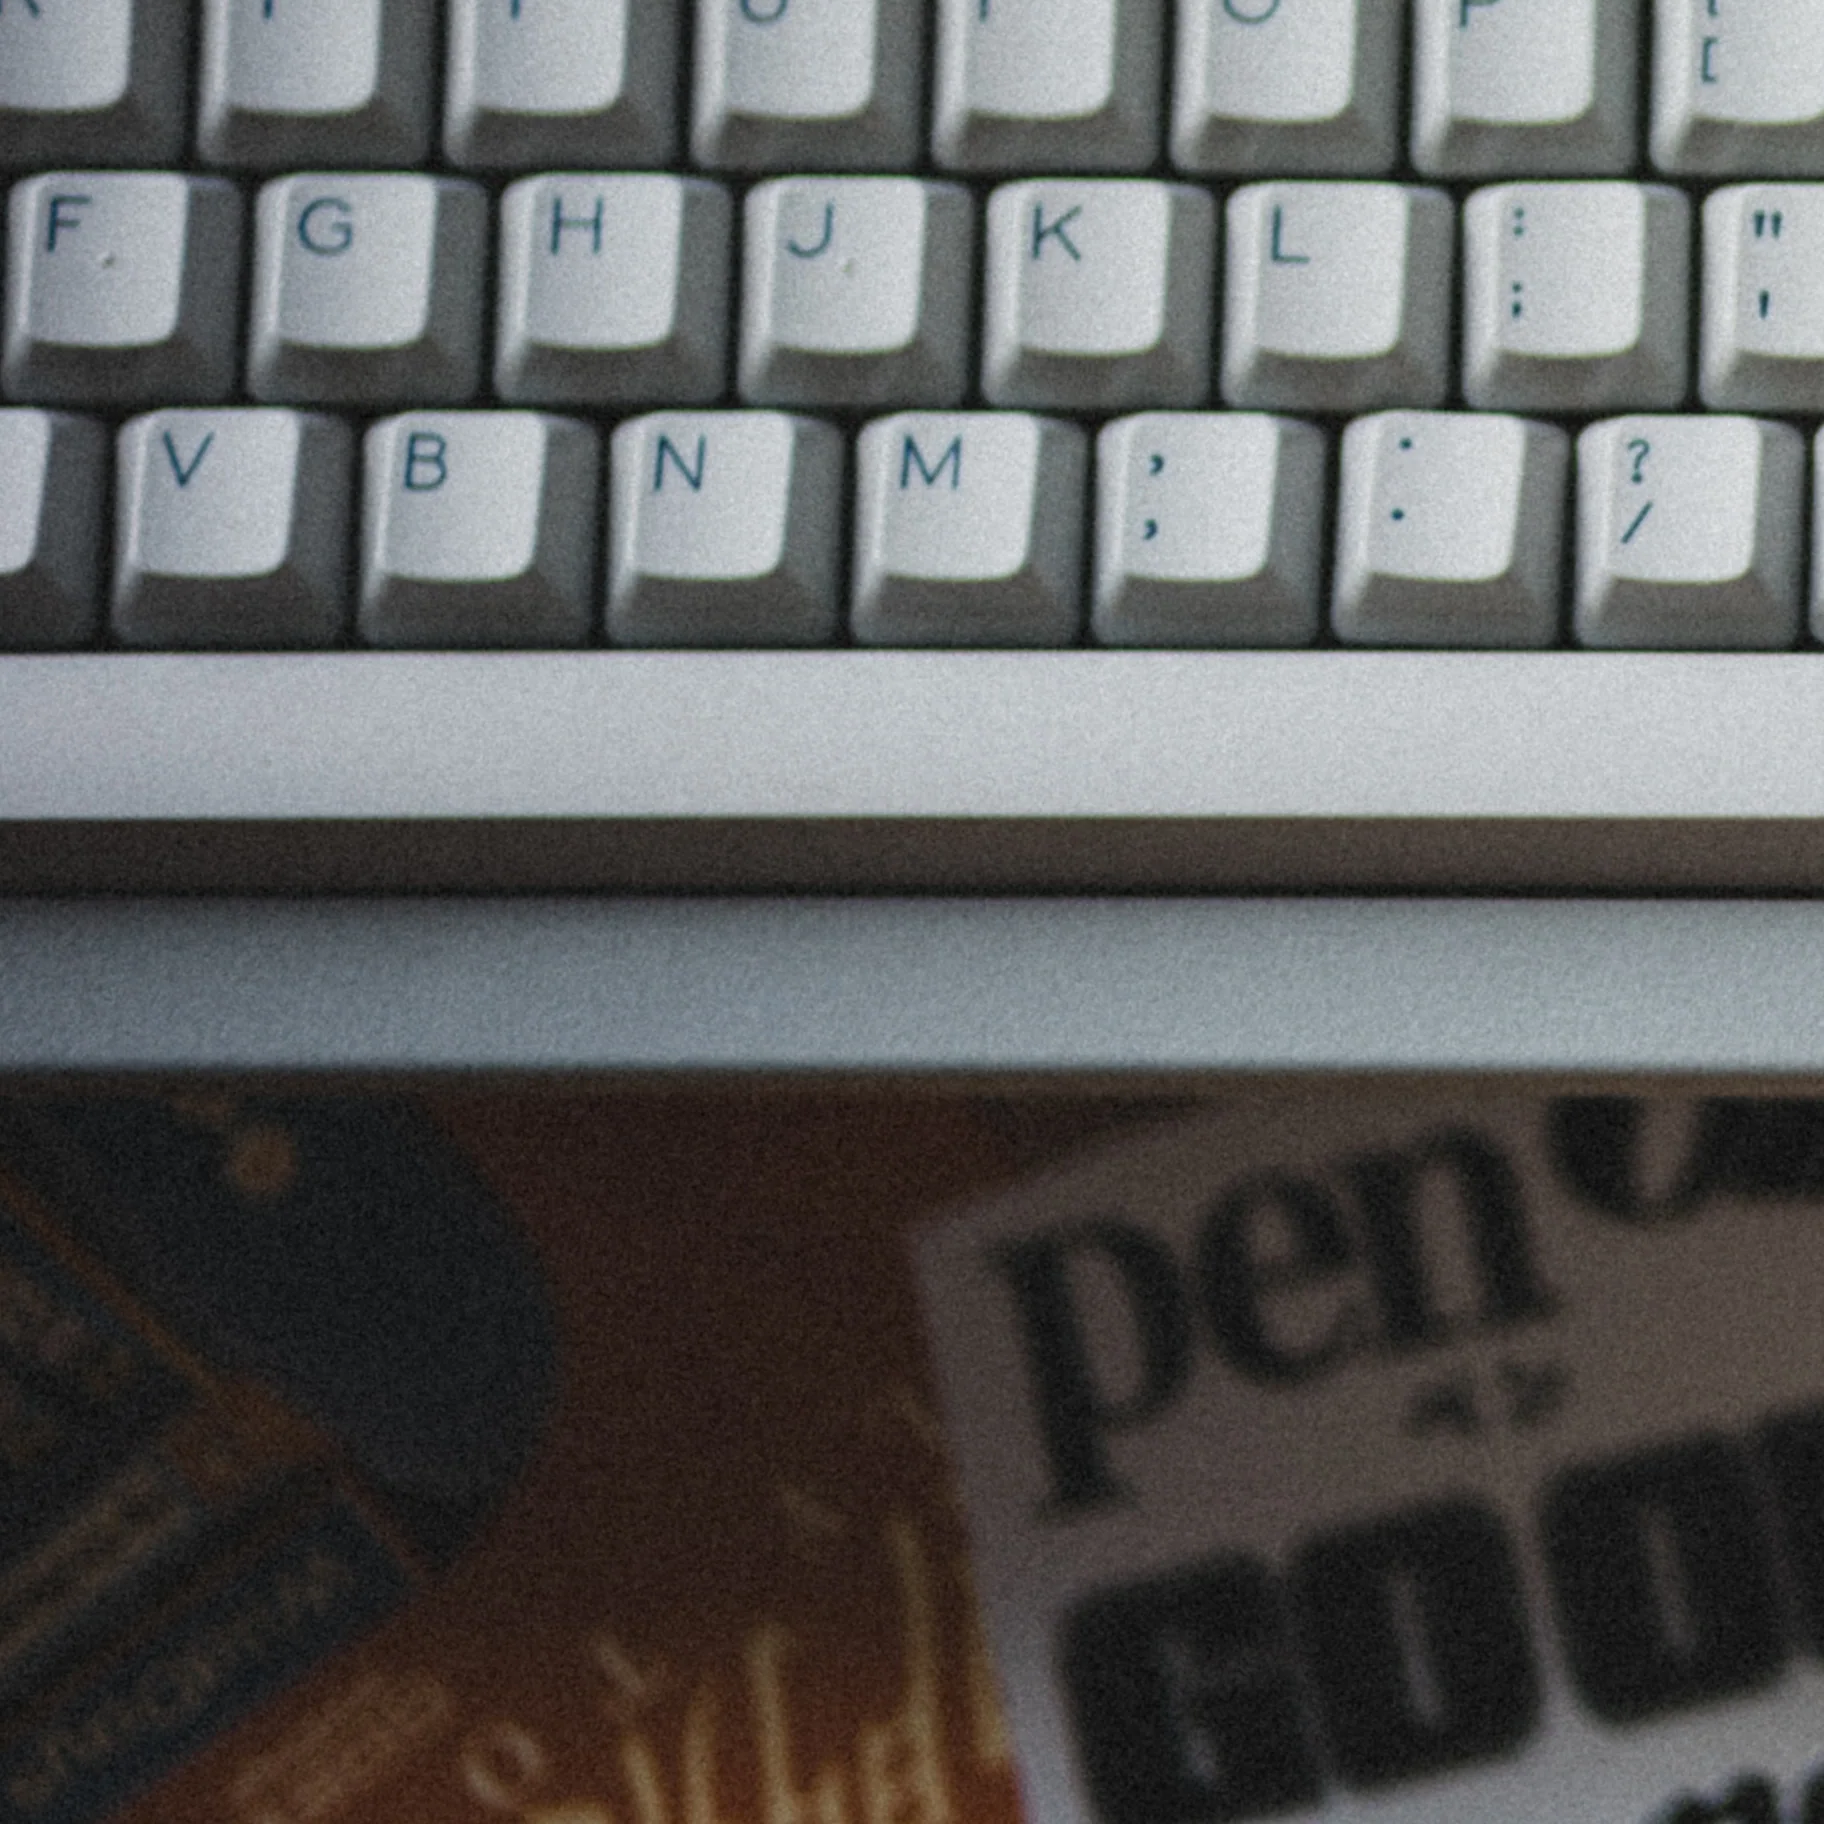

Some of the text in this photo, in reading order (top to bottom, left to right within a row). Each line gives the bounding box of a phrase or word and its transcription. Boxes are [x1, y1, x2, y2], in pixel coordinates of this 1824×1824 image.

[1698, 35, 1719, 86] [
[43, 193, 90, 254] F
[294, 196, 354, 257] G
[547, 195, 604, 257] H
[784, 202, 835, 261] J
[1029, 203, 1082, 261] K
[1268, 204, 1309, 266] L
[160, 429, 213, 490] V
[401, 430, 448, 493] B
[651, 433, 707, 493] N
[898, 433, 963, 490] M
[1626, 437, 1652, 486] ?
[1619, 501, 1654, 546] /
